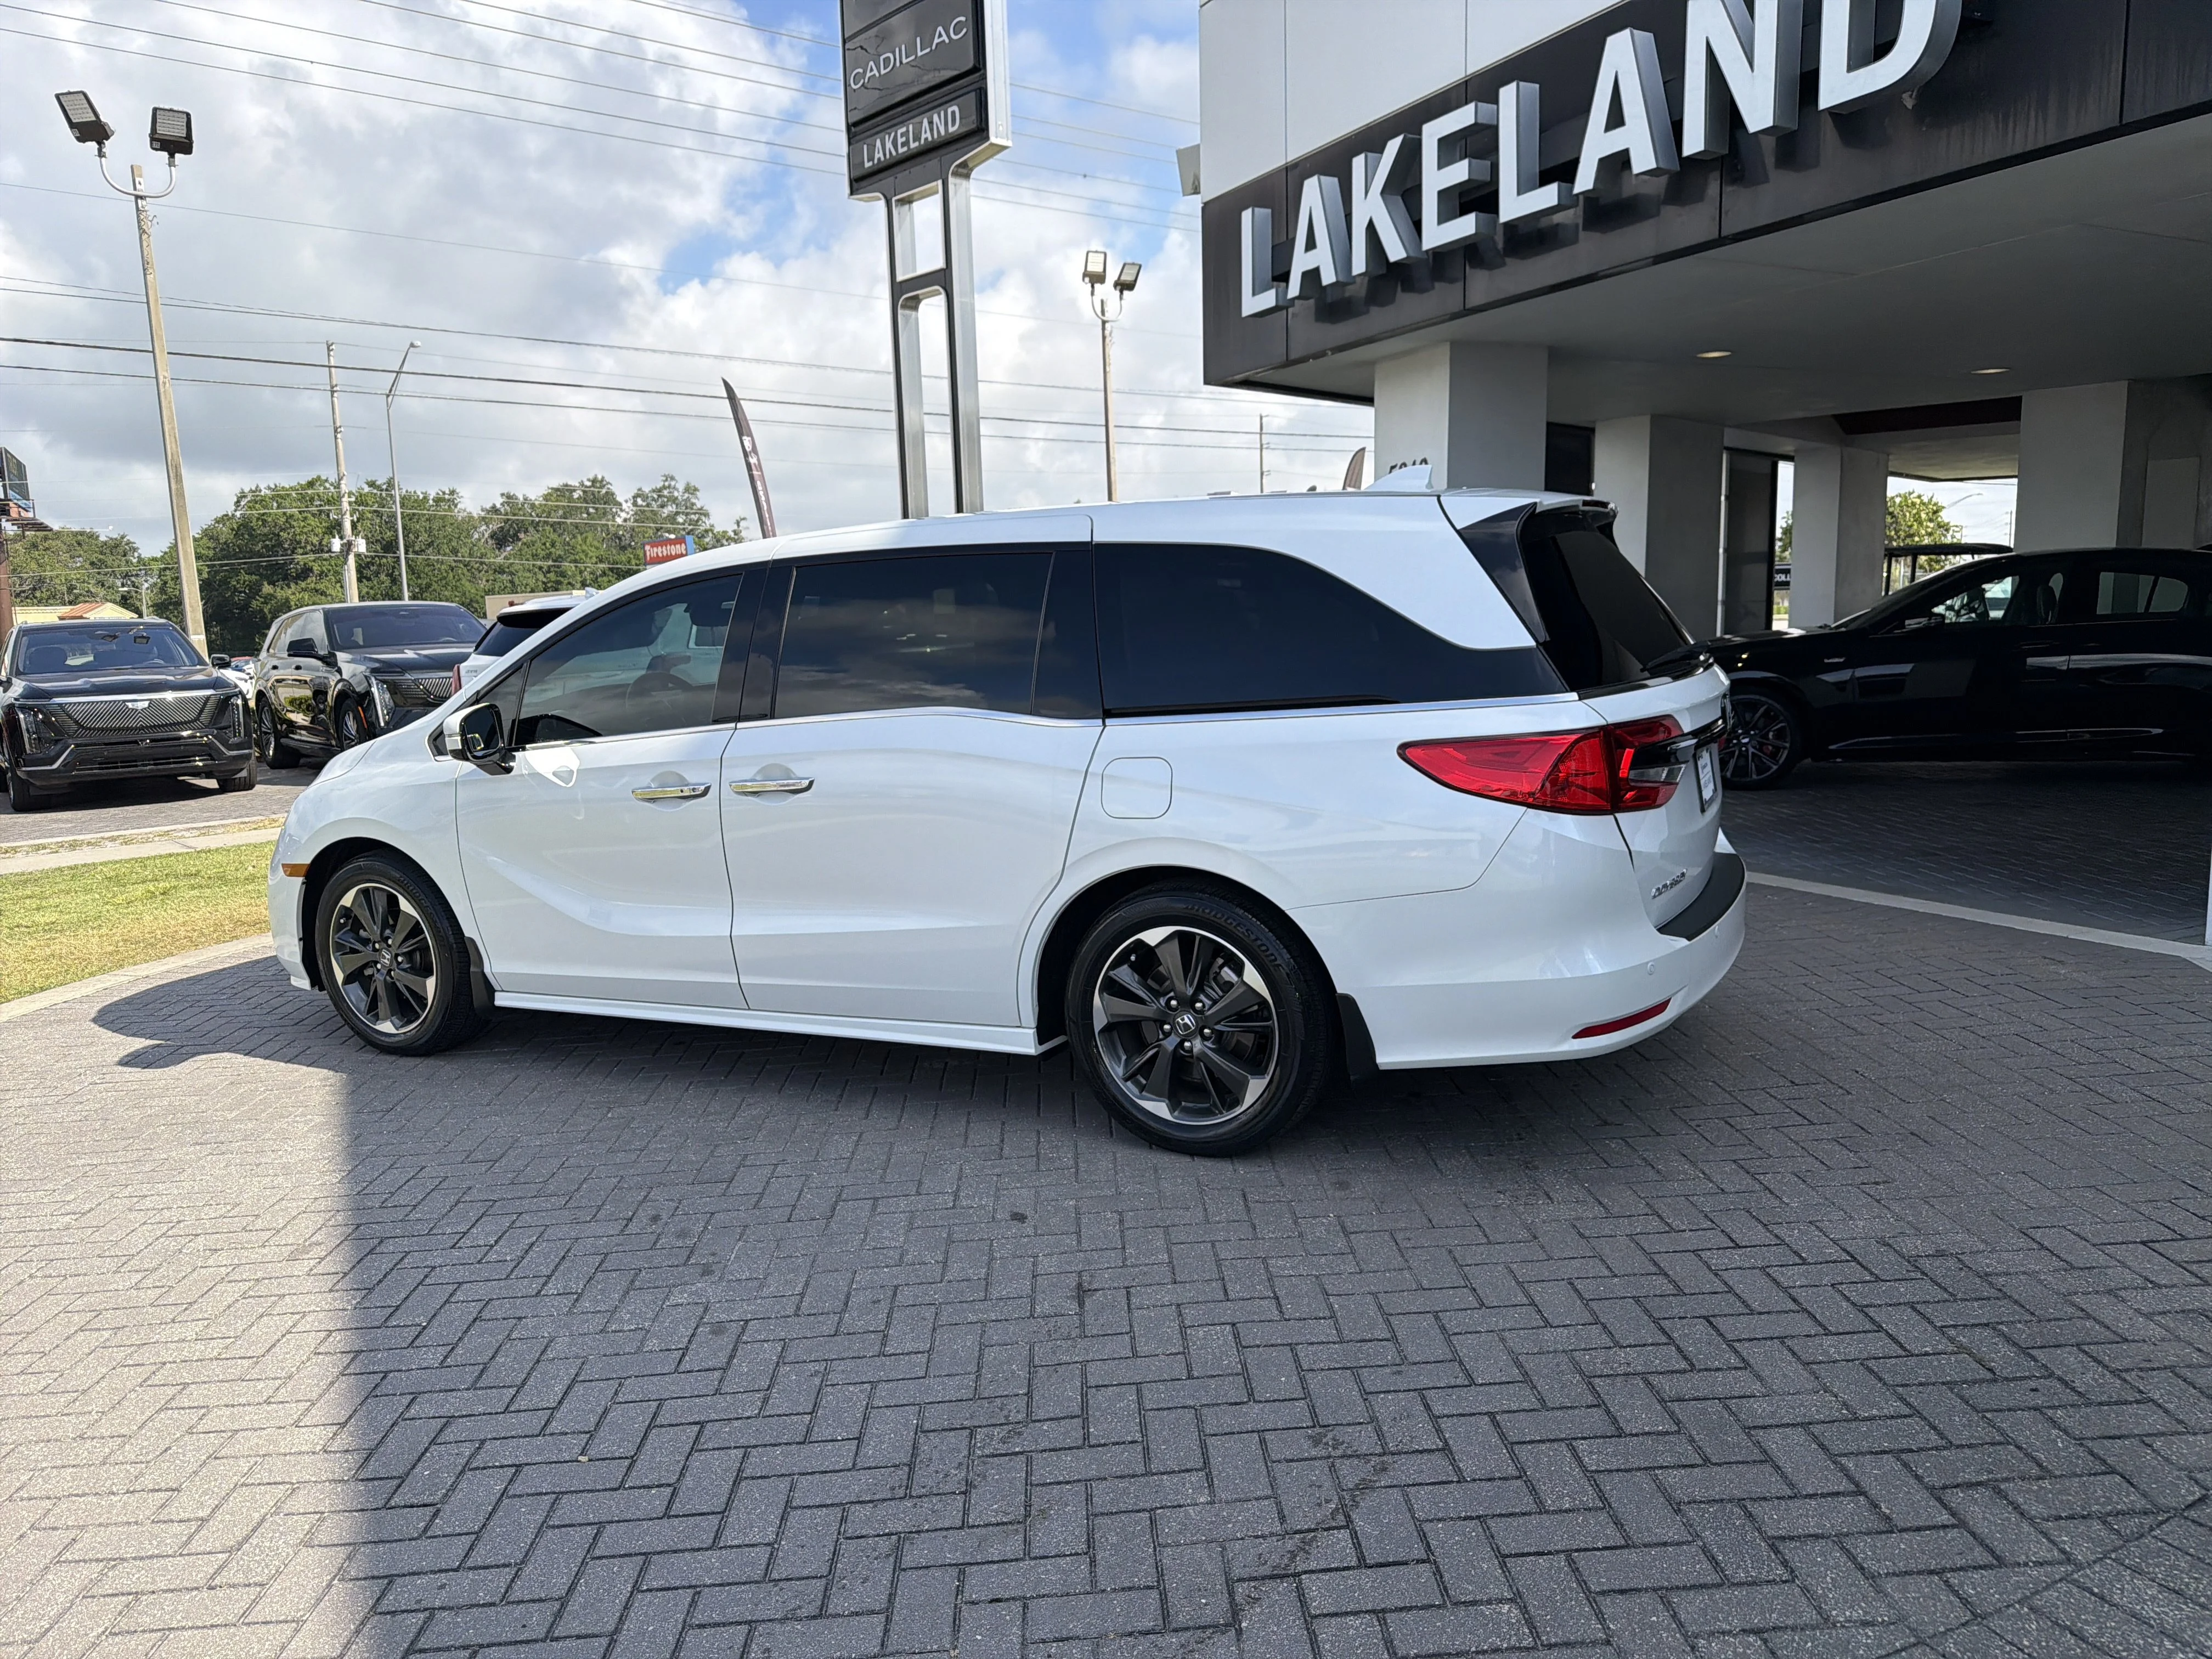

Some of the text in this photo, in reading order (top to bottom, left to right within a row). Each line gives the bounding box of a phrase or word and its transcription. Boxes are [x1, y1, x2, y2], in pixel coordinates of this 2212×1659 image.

[849, 16, 968, 89] CADILLAC
[863, 105, 961, 168] LAKELAND
[1241, 0, 1962, 318] LAKELAND
[645, 543, 686, 561] Firestone
